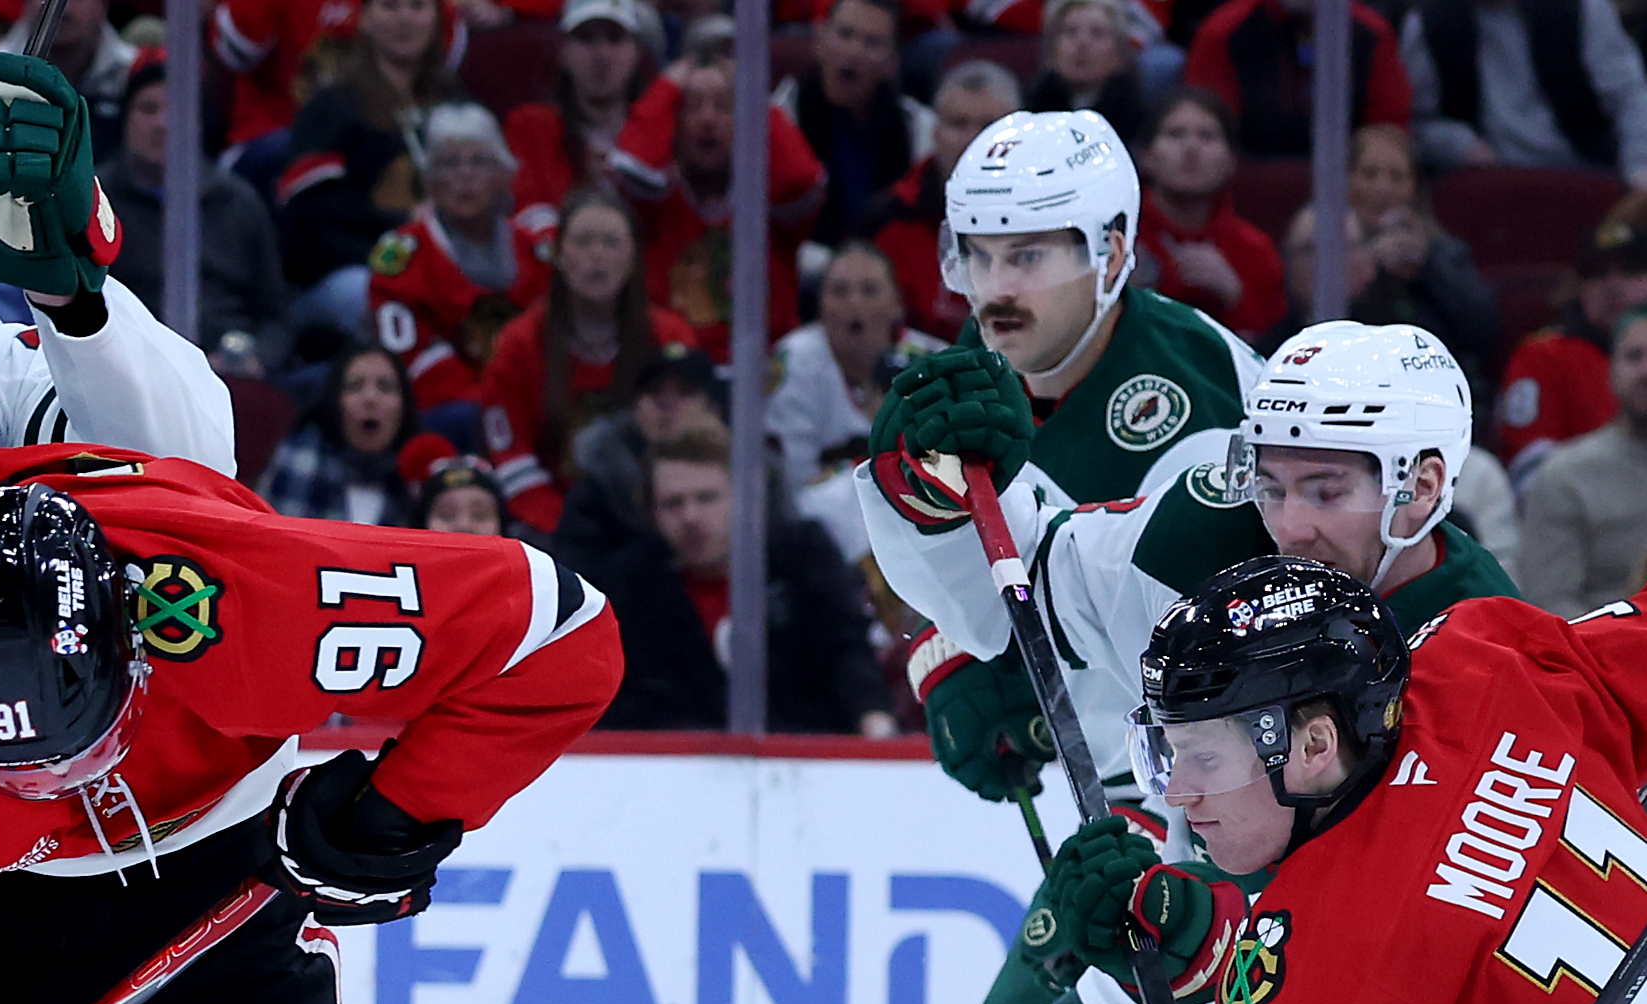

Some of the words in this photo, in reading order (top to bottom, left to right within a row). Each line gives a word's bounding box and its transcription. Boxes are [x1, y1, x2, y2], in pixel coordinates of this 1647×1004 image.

[1256, 399, 1308, 412] CCM
[56, 559, 72, 618] BELLE
[71, 567, 85, 612] TIRE
[1262, 582, 1318, 608] BELLE
[1273, 598, 1315, 617] TIRE
[315, 564, 425, 693] 91
[1425, 731, 1576, 919] MOORE
